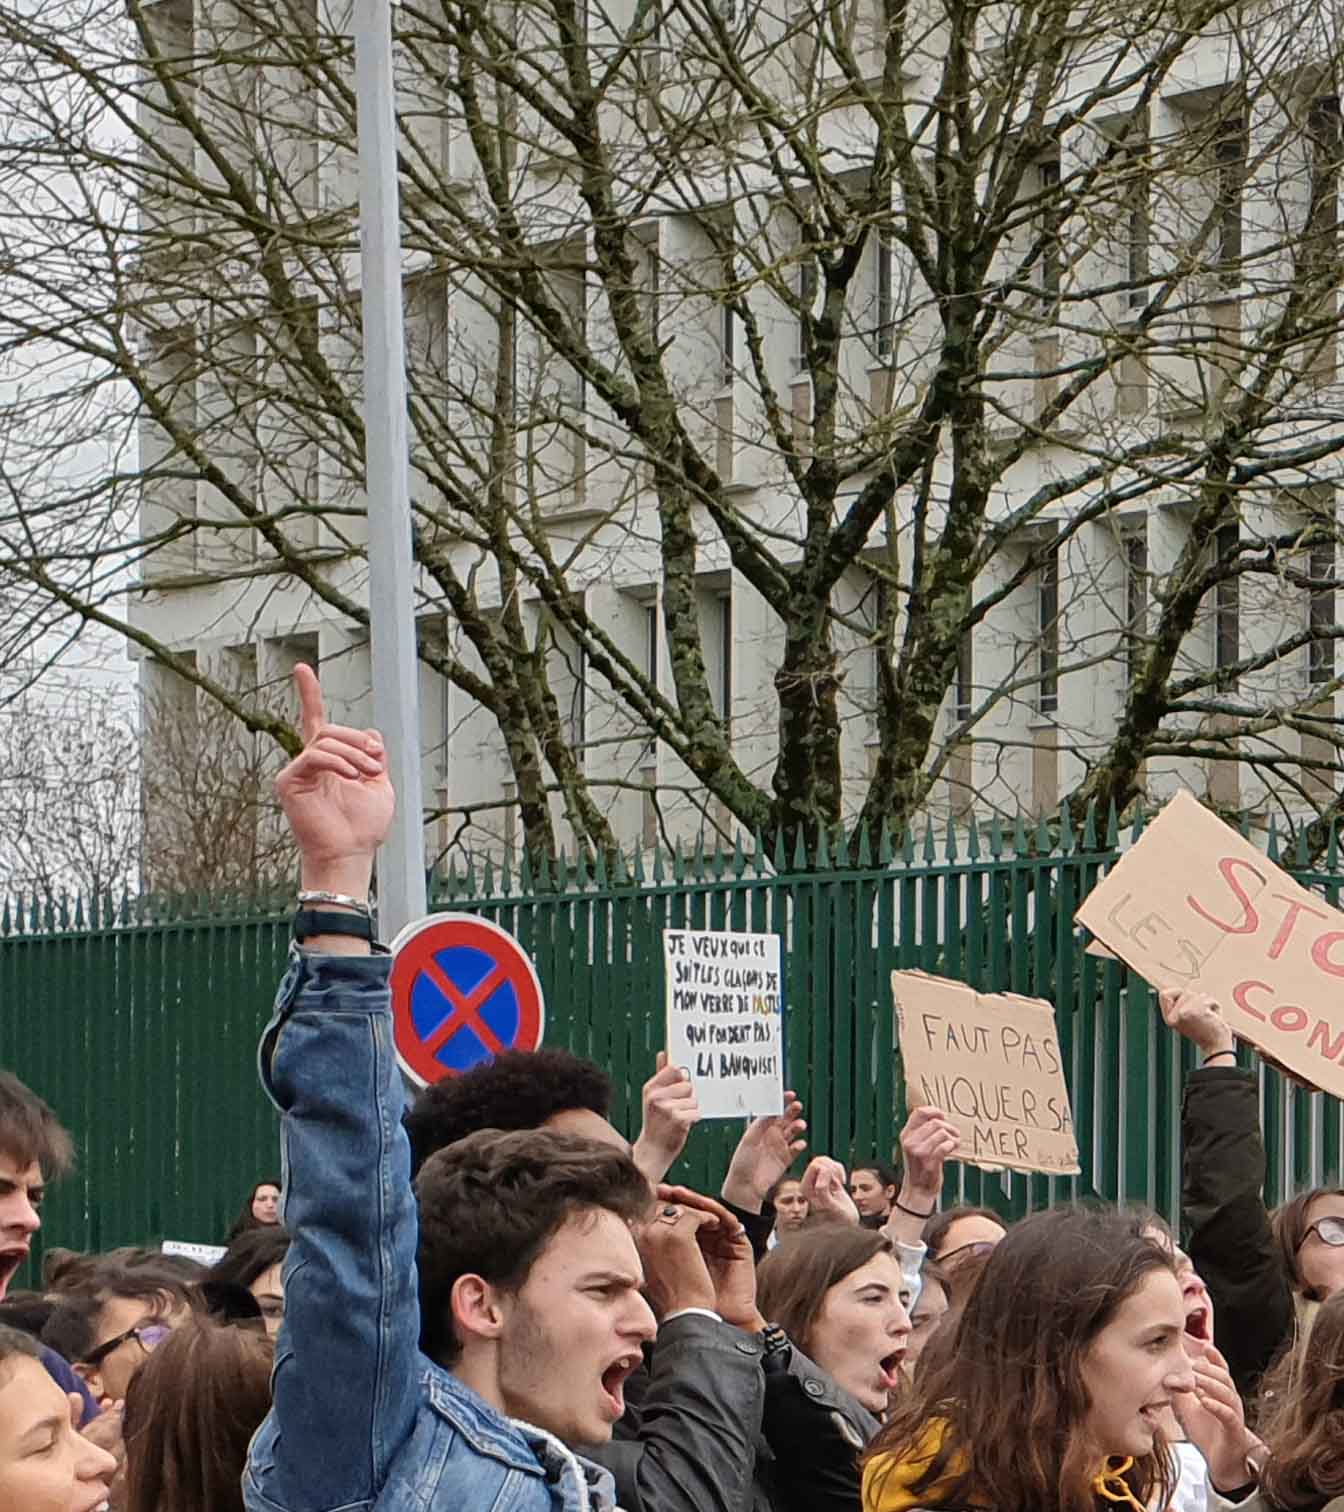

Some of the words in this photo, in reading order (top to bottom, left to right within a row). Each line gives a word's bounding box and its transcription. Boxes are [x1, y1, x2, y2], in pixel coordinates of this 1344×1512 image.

[668, 934, 685, 955] JE
[693, 936, 728, 958] VEUX
[753, 939, 766, 957] CE
[1107, 893, 1201, 980] LES
[701, 964, 720, 987] LES
[766, 971, 778, 990] DE
[673, 989, 698, 1012] MON
[699, 993, 733, 1014] VERRE
[736, 994, 749, 1014] DE
[709, 1023, 751, 1045] FONDENT
[753, 1021, 770, 1042] PAS
[922, 1013, 991, 1054] FAUT
[1001, 1026, 1060, 1075] PAS
[697, 1051, 714, 1078] LA
[920, 1072, 1040, 1127] NIQUER
[1047, 1097, 1073, 1134] SA
[973, 1124, 1030, 1159] MER
